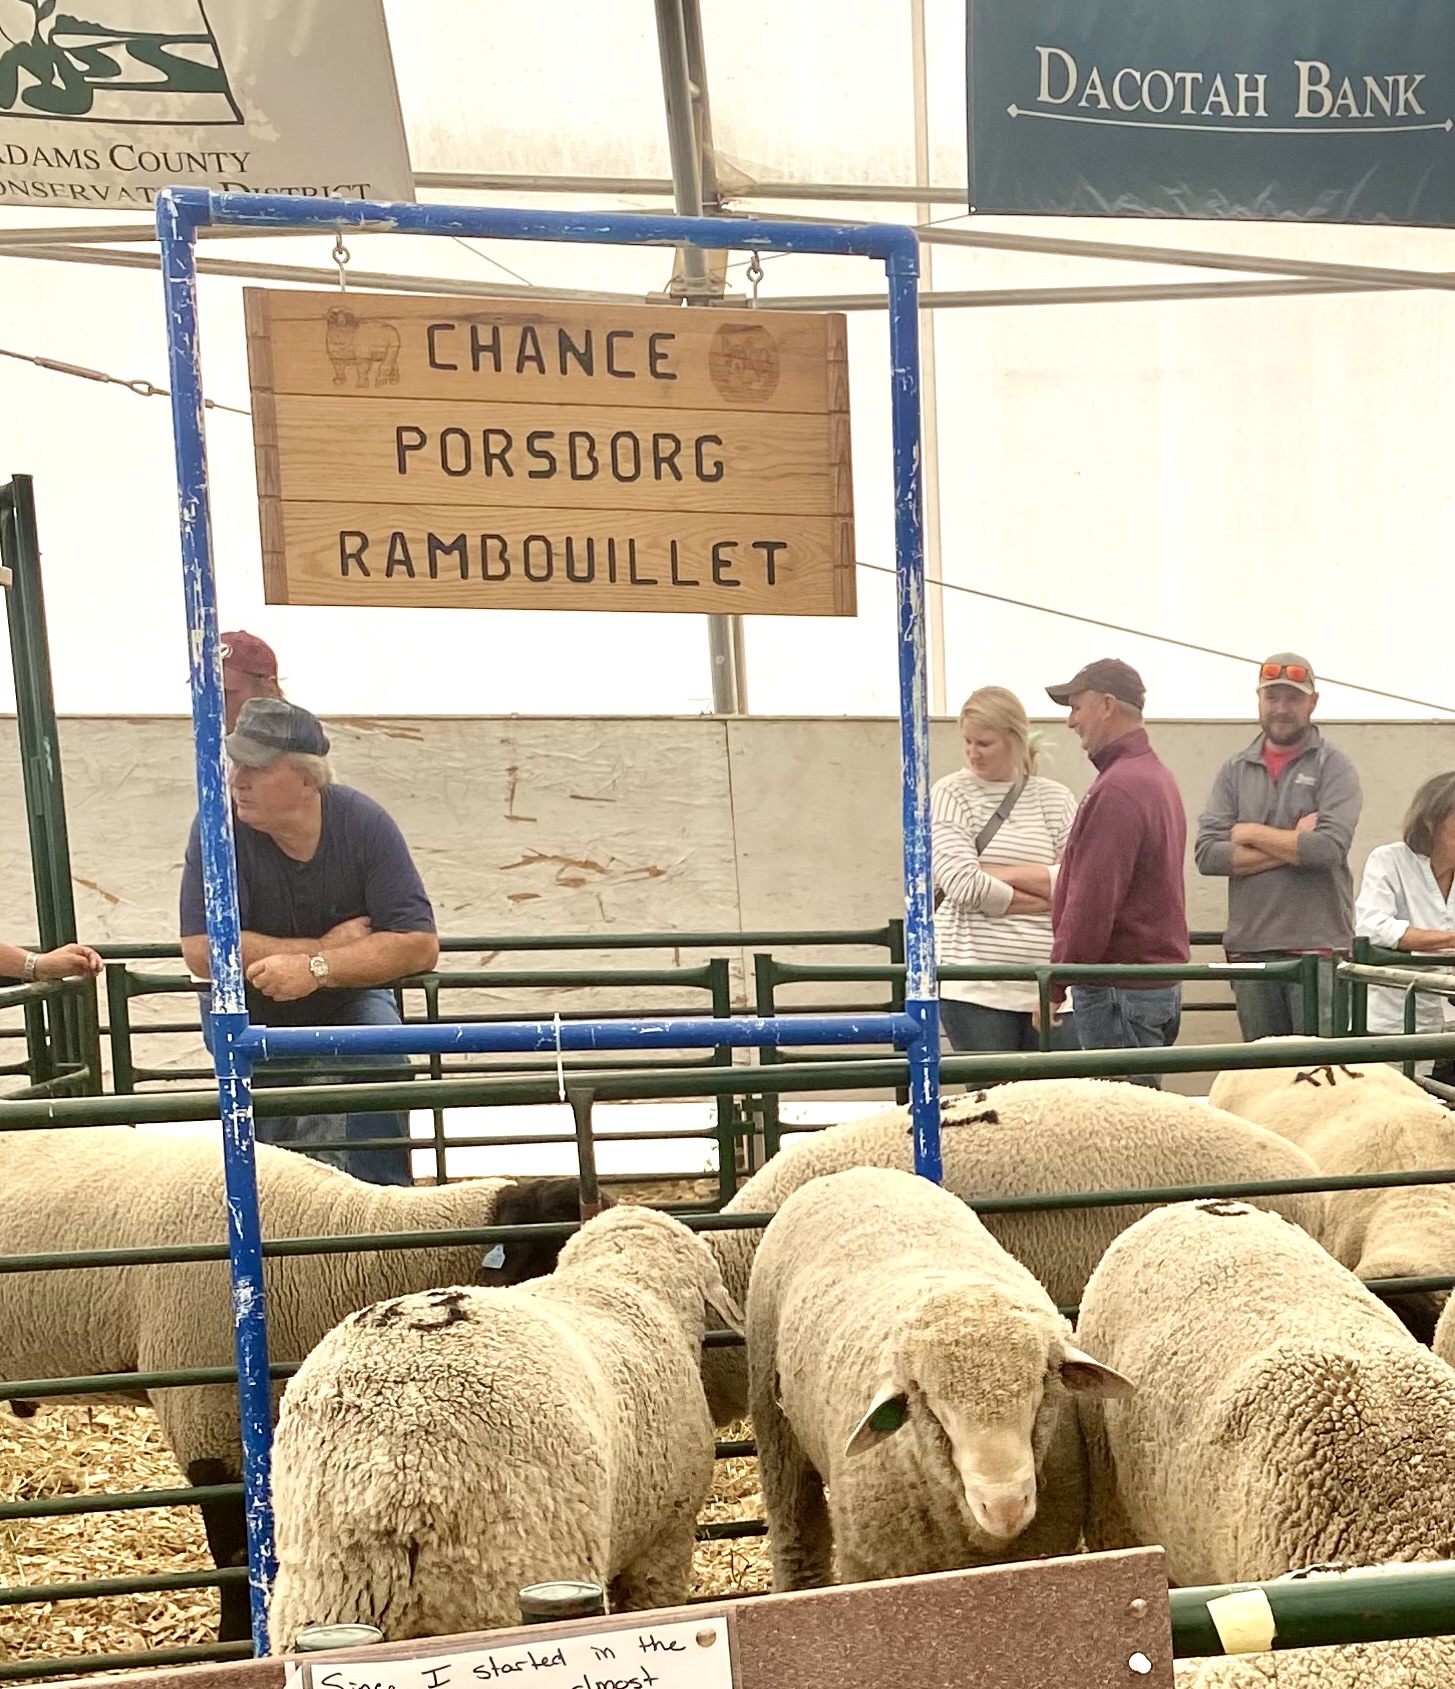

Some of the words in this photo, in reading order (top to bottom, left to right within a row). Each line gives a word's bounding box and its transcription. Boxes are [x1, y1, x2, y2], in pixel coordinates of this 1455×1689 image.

[0, 144, 101, 171] DAMS
[426, 323, 678, 381] CHANCE
[395, 425, 725, 484] PORSBORG
[338, 530, 788, 587] RAMBOUILLET
[421, 1664, 452, 1689] I
[472, 1648, 567, 1680] started
[590, 1646, 617, 1661] in
[639, 1634, 687, 1654] the
